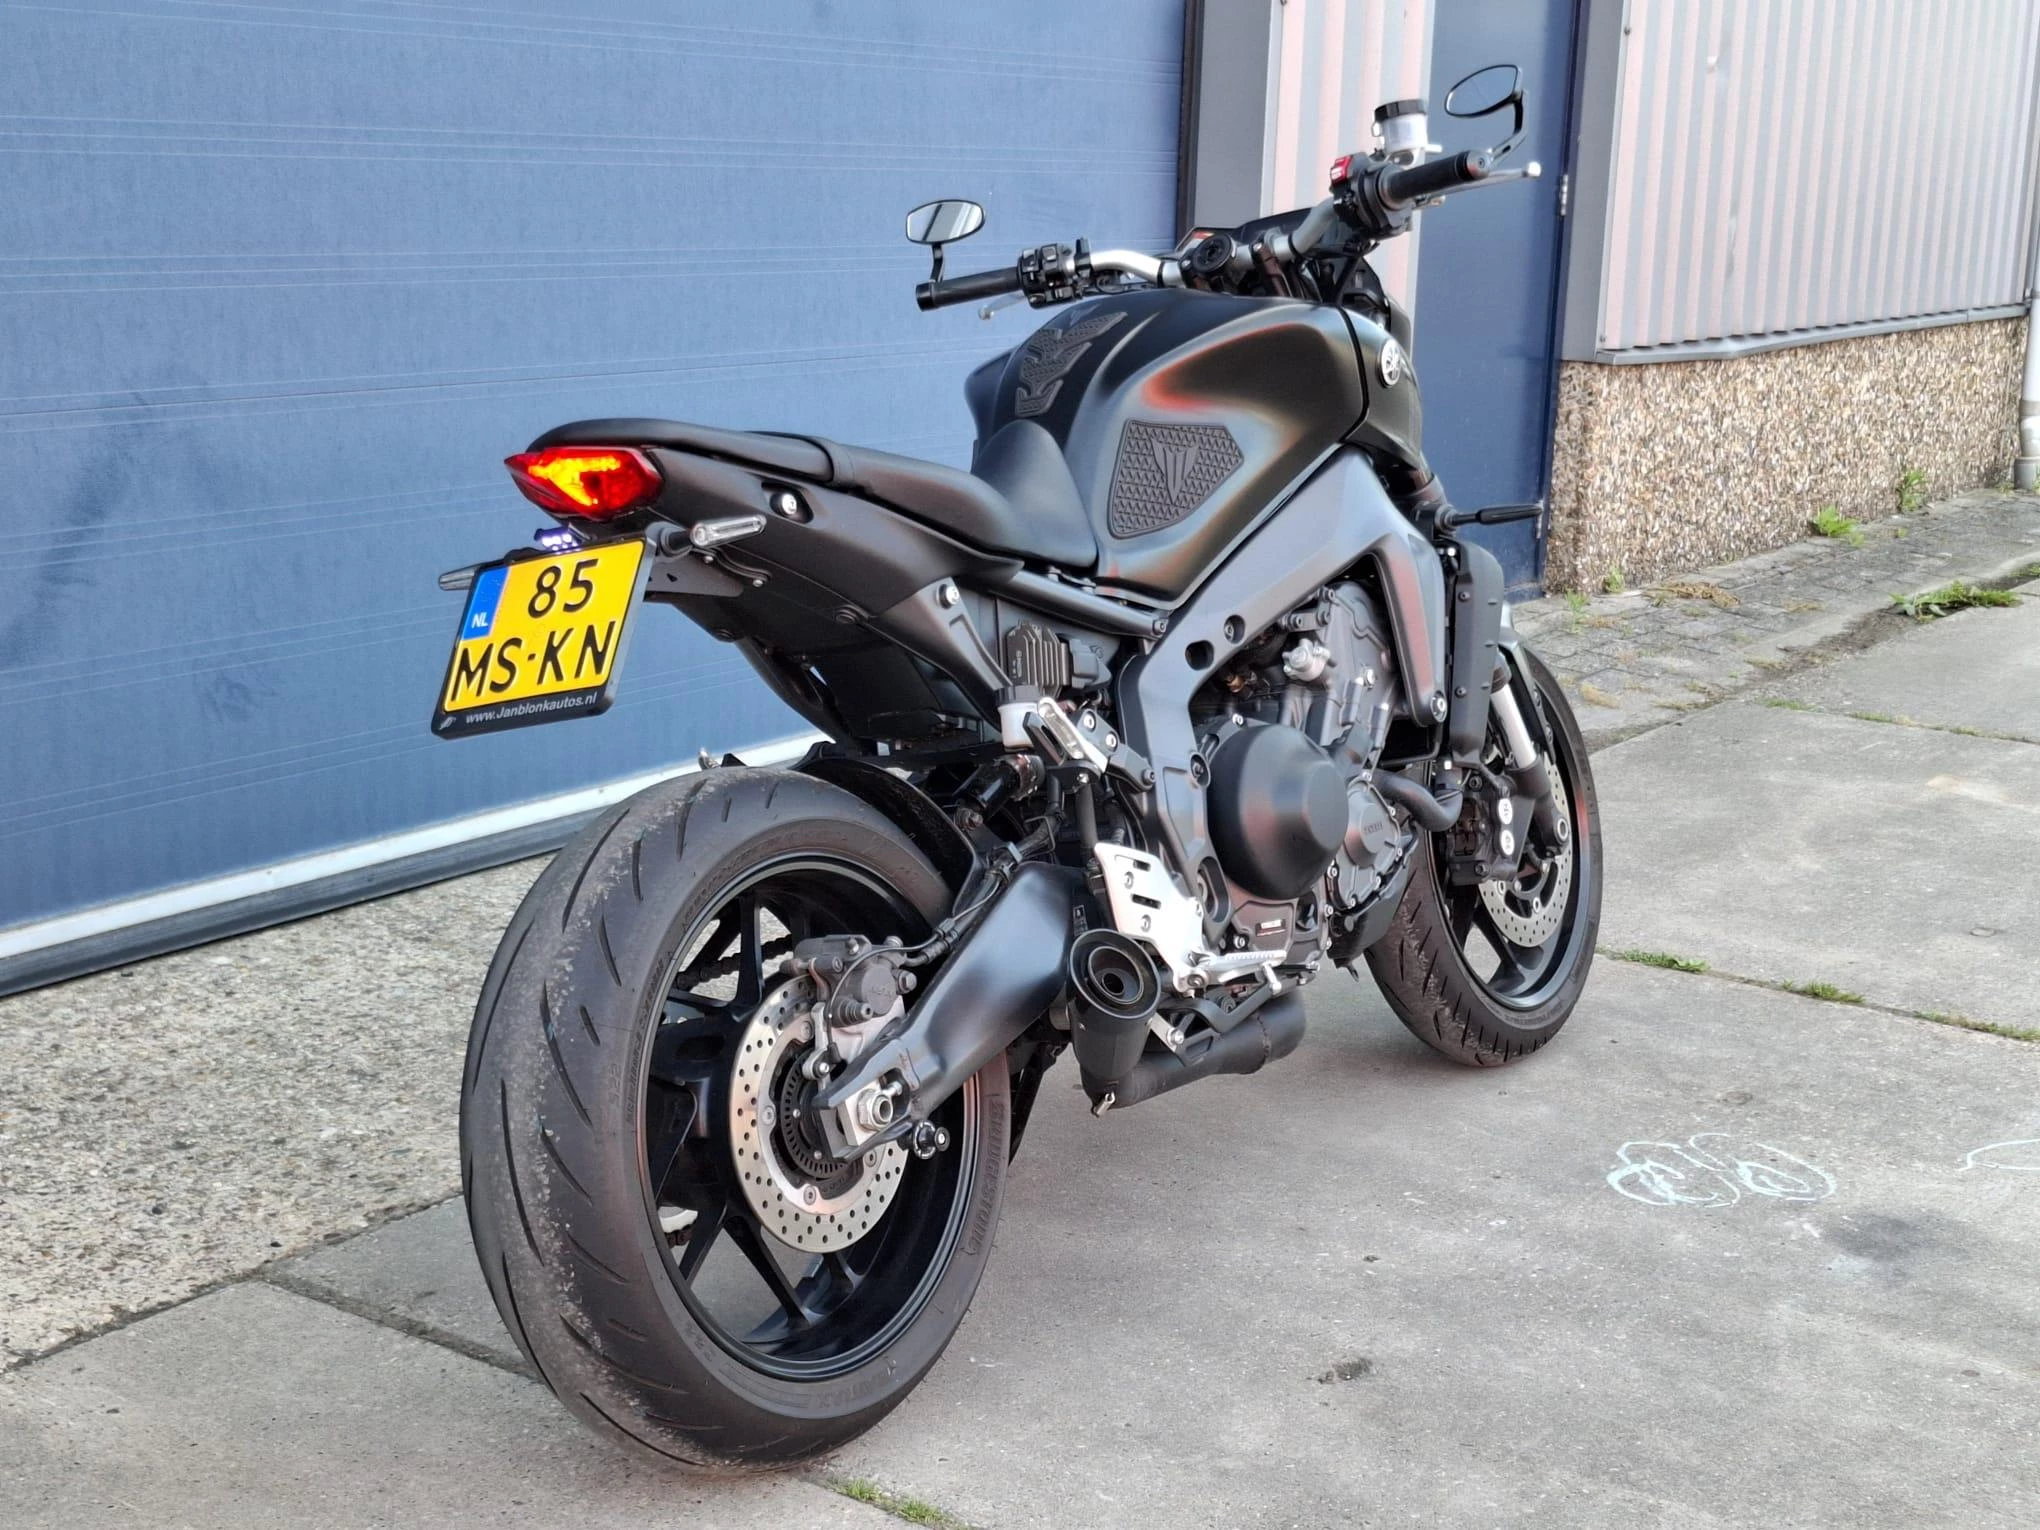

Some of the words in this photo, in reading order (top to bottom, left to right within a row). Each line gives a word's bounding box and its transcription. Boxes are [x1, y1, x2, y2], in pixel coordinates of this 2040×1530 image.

[528, 558, 598, 619] 85
[472, 611, 489, 629] NL
[465, 692, 598, 724] www.Janblonkautos.nl
